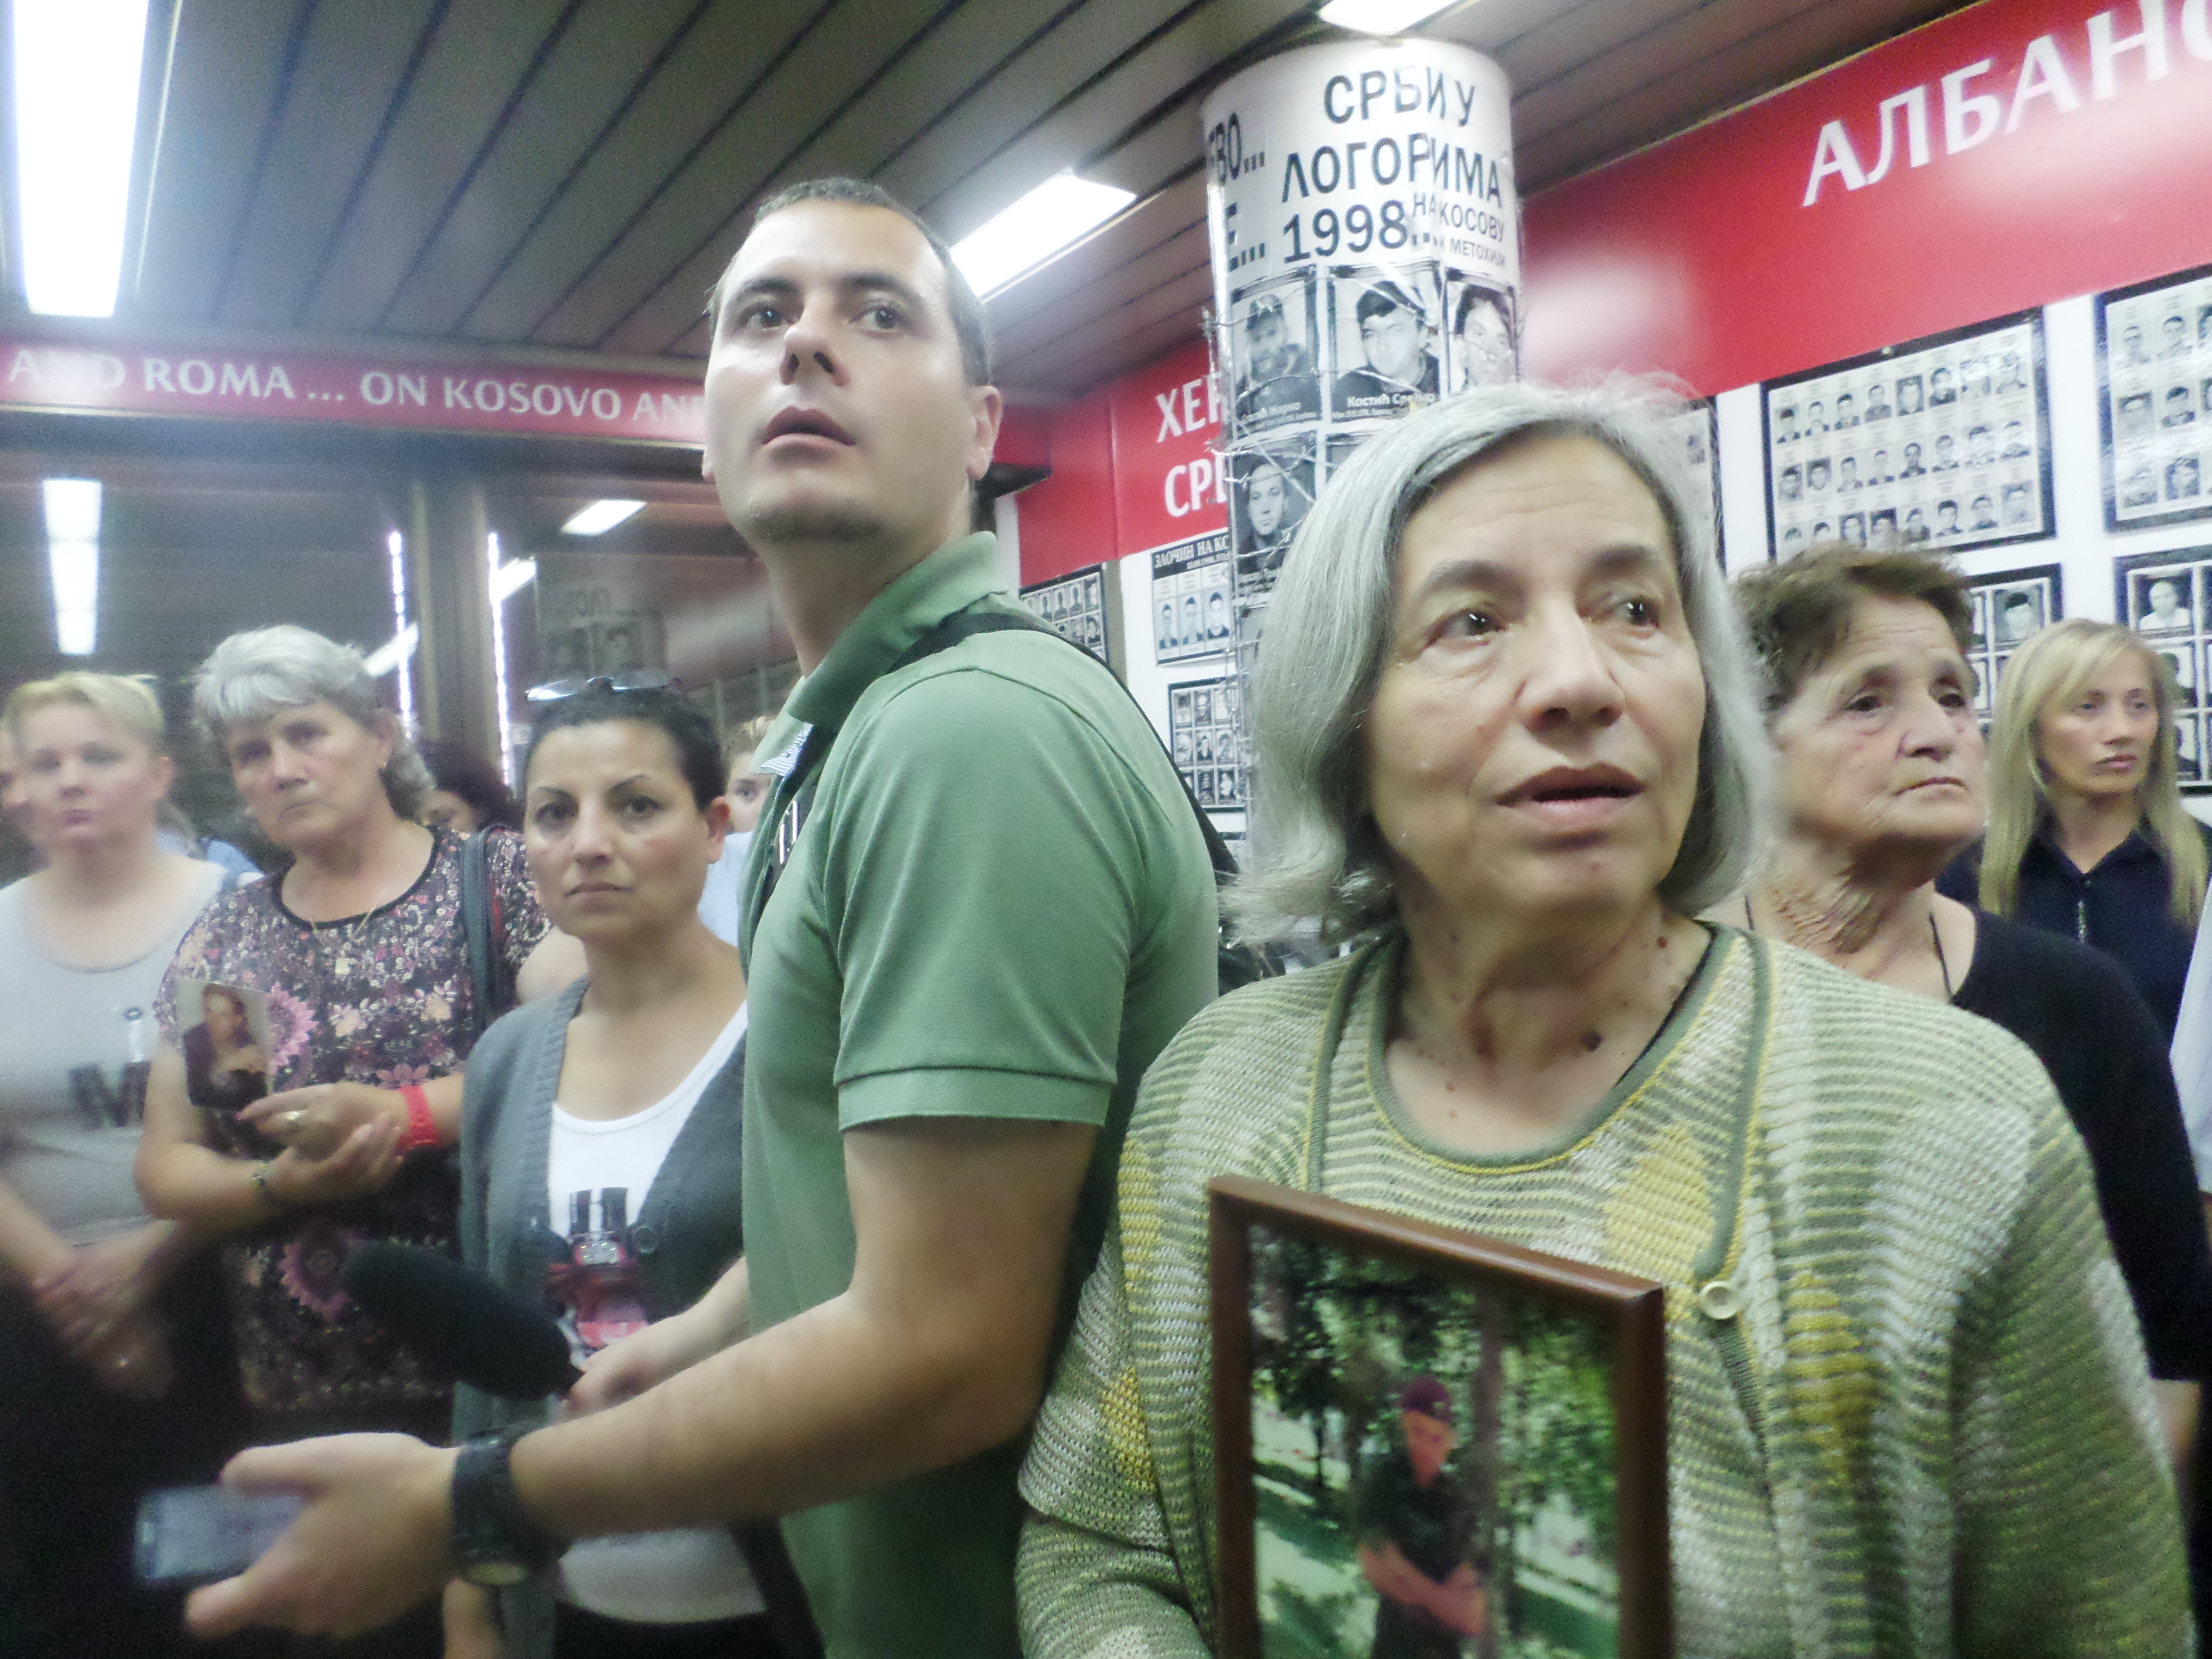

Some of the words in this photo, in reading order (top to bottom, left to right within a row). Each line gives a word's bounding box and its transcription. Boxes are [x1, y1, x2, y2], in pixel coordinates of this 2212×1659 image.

[1323, 66, 1446, 124] СРБИ
[1282, 132, 1503, 209] ЛОГОРИМА
[1413, 192, 1436, 217] НА
[1440, 202, 1504, 242] КОСОВУ
[144, 358, 295, 399] ROMA
[360, 372, 426, 406] ON
[444, 377, 621, 420] KOSOVO
